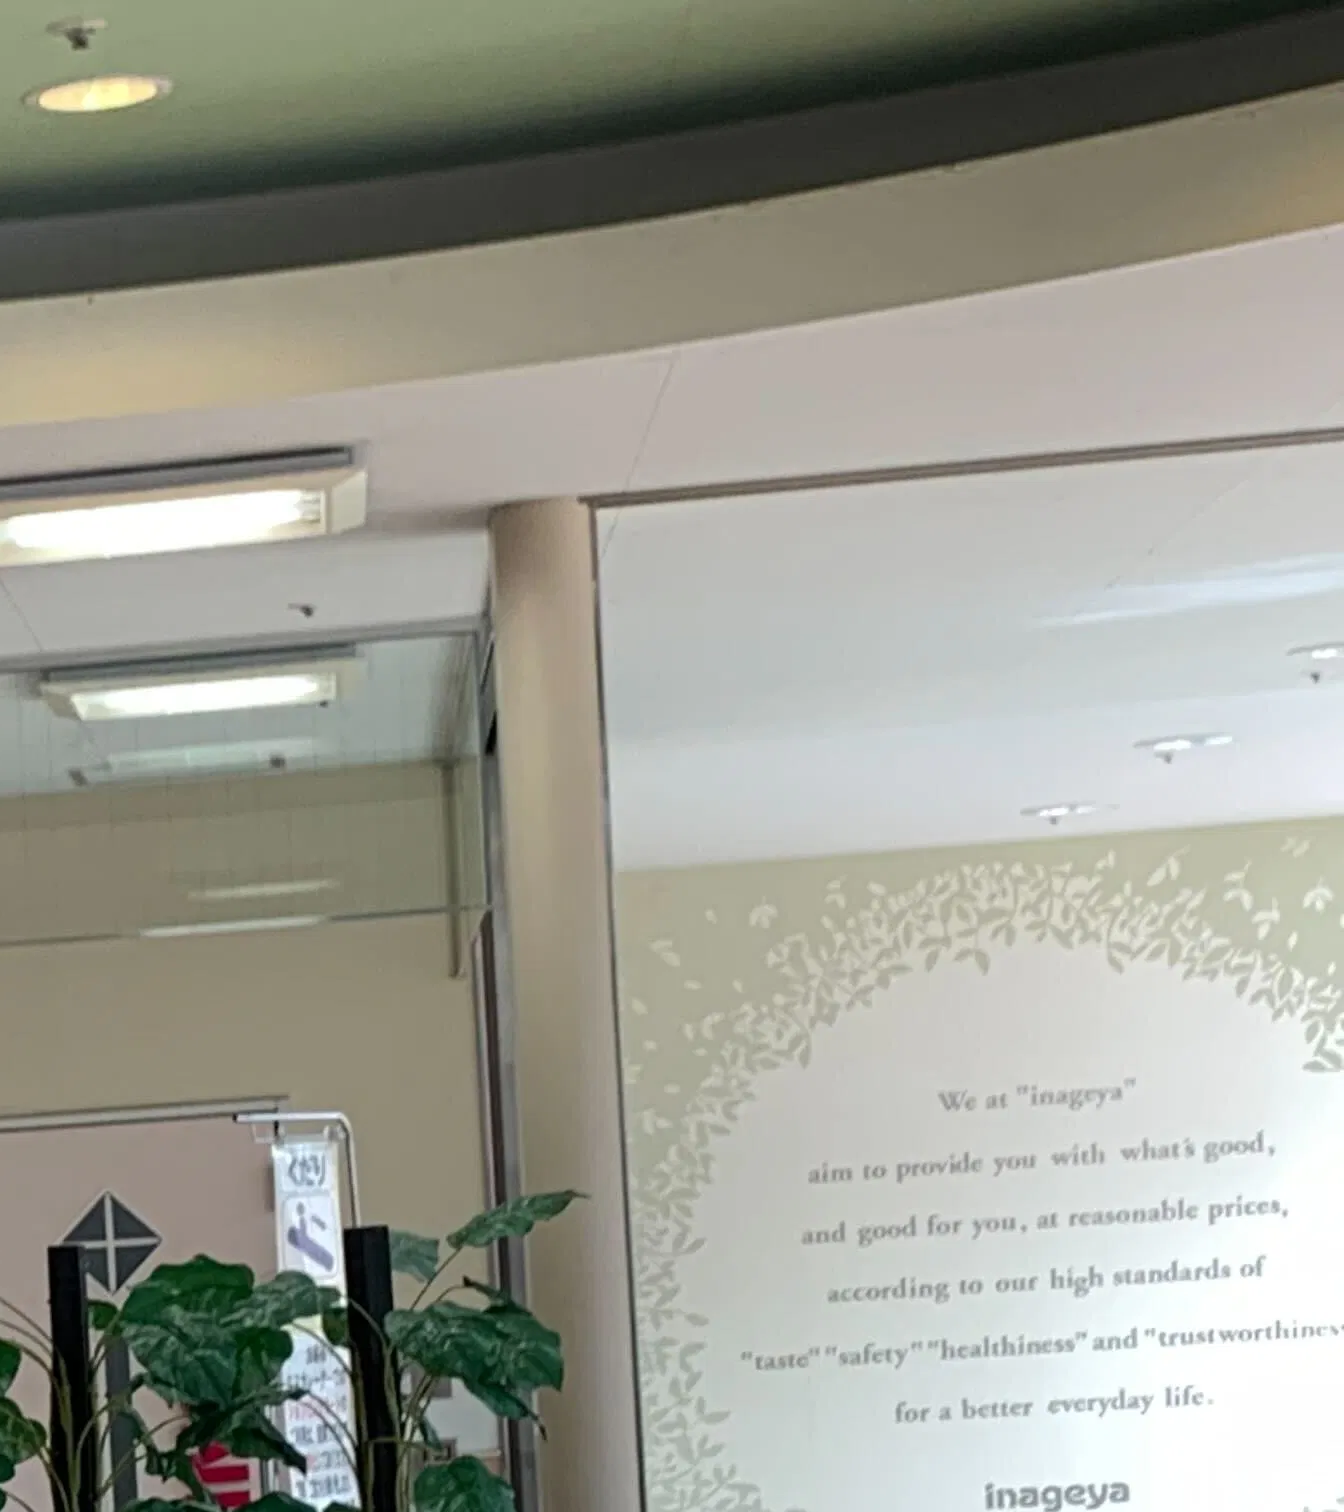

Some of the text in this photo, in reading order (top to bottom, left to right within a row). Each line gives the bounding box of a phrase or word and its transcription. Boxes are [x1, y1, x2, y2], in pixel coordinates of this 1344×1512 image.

[938, 1078, 1136, 1111] We at "inageya"
[808, 1130, 1275, 1184] aim to provide you with what's good,
[802, 1195, 1288, 1246] and good for you, at reasonable prices,
[828, 1255, 1266, 1303] according to our high standards of
[1093, 1327, 1138, 1351] and
[896, 1385, 1212, 1424] for a better everyday life.
[985, 1482, 1130, 1512] inageya
